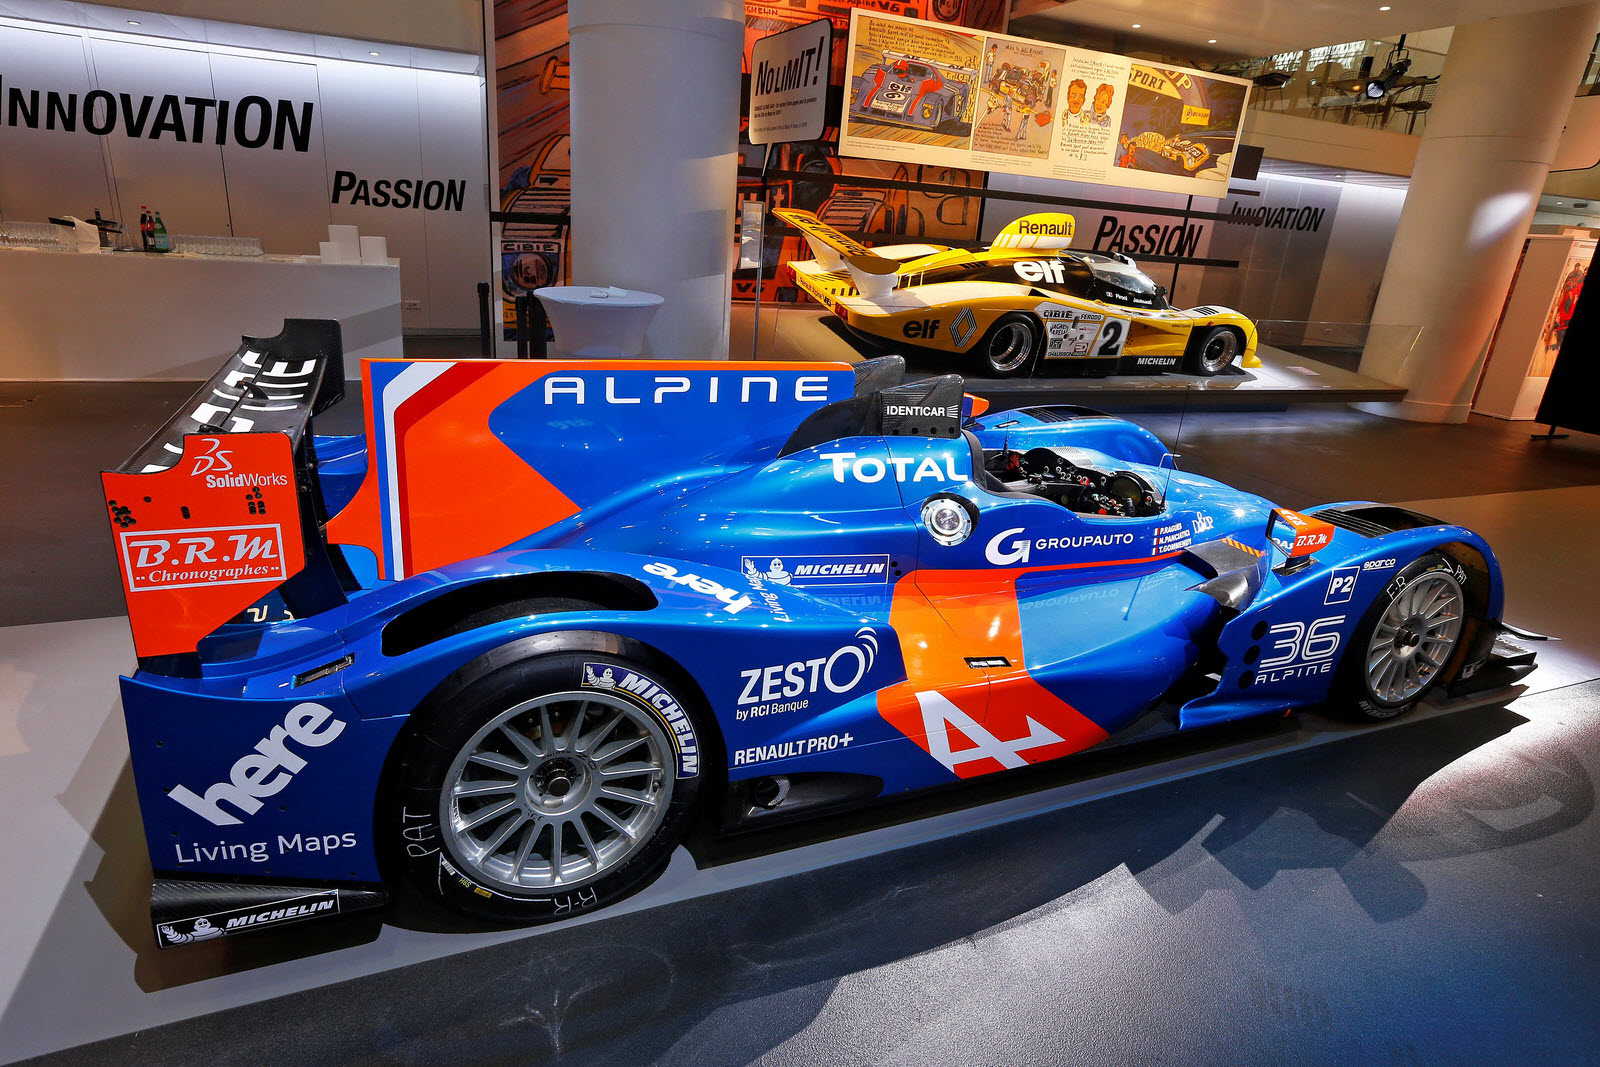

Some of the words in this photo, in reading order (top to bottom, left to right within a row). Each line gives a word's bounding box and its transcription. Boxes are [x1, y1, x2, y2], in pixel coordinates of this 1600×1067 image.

[0, 74, 314, 153] NNOVATION
[331, 170, 467, 212] PASSION
[1018, 219, 1073, 236] Renault
[1092, 215, 1204, 257] PASSION
[1013, 260, 1066, 284] elf
[902, 319, 941, 339] elf
[1097, 321, 1123, 356] 2
[1136, 357, 1177, 366] MICHELIN
[543, 376, 829, 405] ALPINE
[886, 405, 946, 418] IDENTICAR
[206, 472, 288, 489] SolidWorks
[818, 453, 969, 484] TOTAL
[1035, 533, 1134, 550] GROUPAUTO
[1296, 533, 1328, 547] B.R.M
[794, 563, 886, 576] MICHELIN
[1329, 575, 1355, 595] P2
[1259, 614, 1346, 669] 36
[736, 645, 866, 706] ZESTO
[1254, 662, 1333, 685] ALPINE
[617, 672, 699, 774] MICHELIN
[735, 709, 749, 722] by
[750, 704, 770, 718] RCI
[770, 699, 809, 715] Banque
[167, 702, 347, 826] here
[734, 740, 807, 766] RENAULT
[175, 839, 269, 863] Living
[277, 832, 358, 856] Maps
[226, 899, 335, 930] MICHELIN
